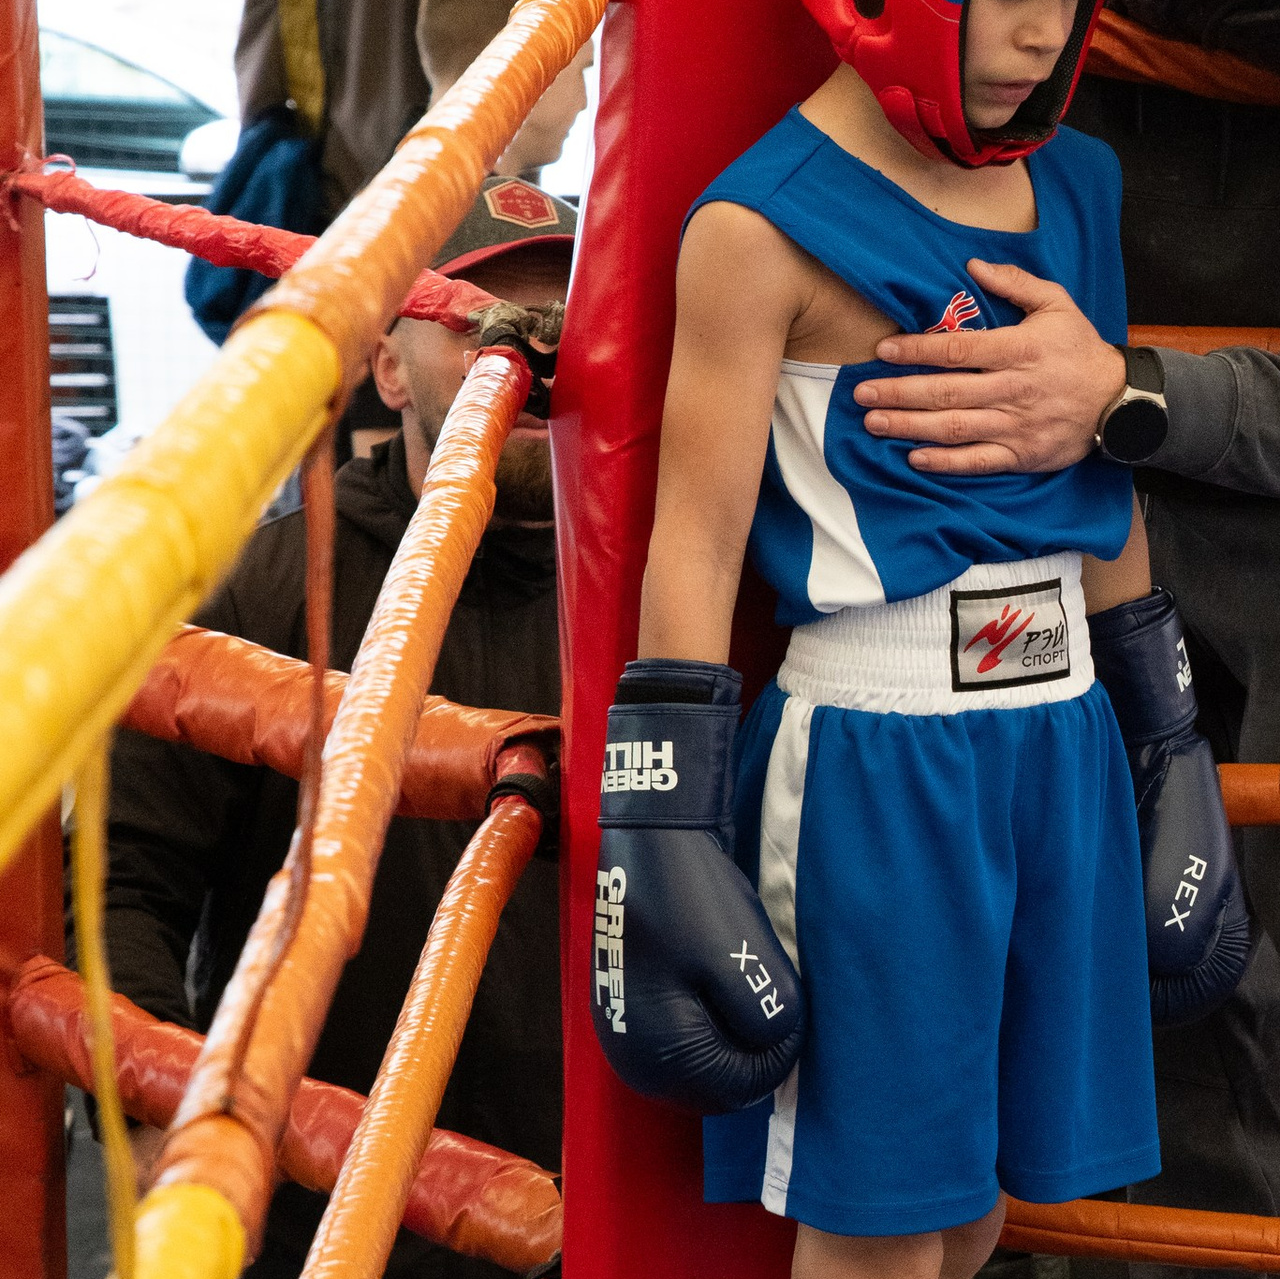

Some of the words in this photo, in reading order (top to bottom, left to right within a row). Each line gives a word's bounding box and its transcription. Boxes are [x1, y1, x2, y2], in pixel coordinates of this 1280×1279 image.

[1022, 650, 1065, 667] СПОРТ
[1023, 620, 1064, 653] РЭЙ
[606, 741, 674, 770] HILL
[1165, 854, 1208, 933] REX
[608, 866, 627, 1034] GREEN
[729, 940, 785, 1021] REX
